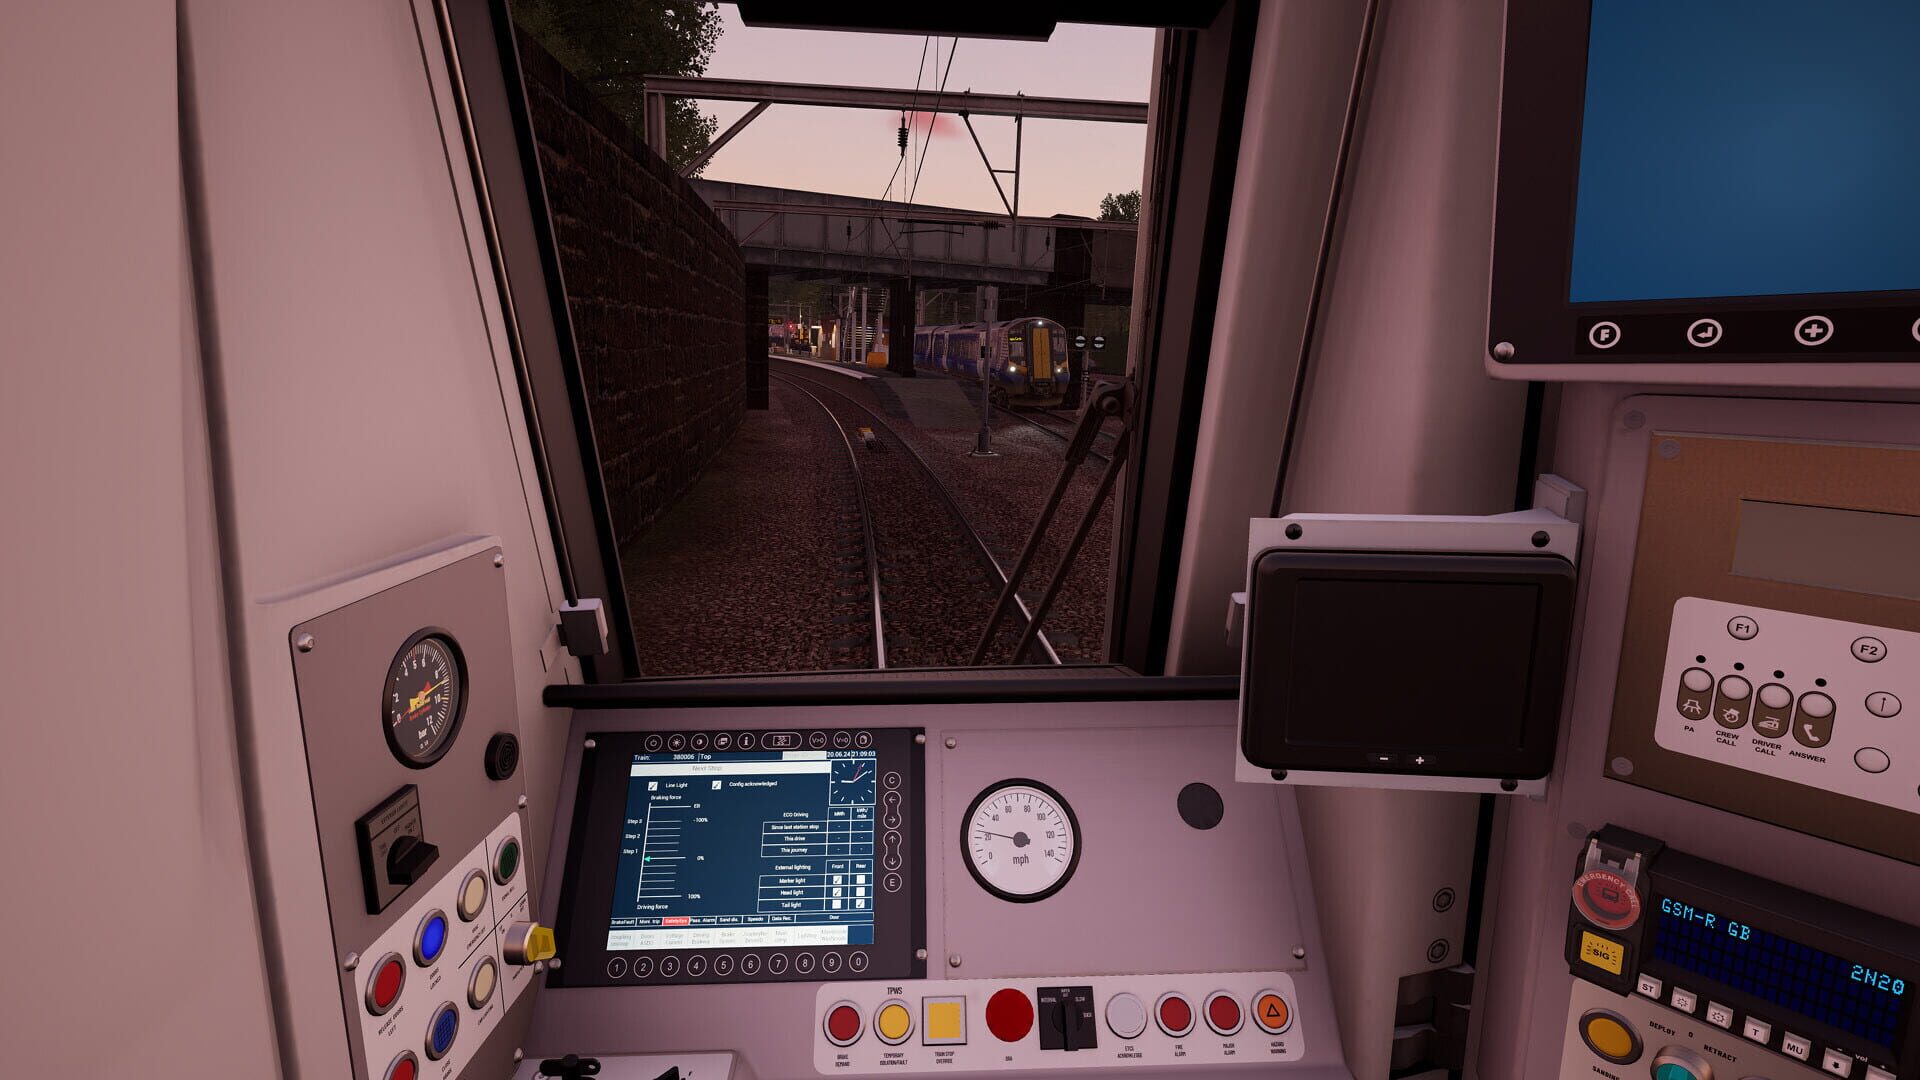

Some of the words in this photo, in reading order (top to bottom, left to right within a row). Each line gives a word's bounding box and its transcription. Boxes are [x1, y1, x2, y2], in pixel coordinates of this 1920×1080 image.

[1600, 329, 1610, 342] F
[1735, 623, 1750, 634] F1
[1860, 644, 1878, 656] F2
[412, 660, 417, 669] 5
[434, 694, 441, 704] 10
[426, 715, 434, 726] 12
[418, 728, 428, 739] bar
[1716, 730, 1739, 740] CREW
[1716, 737, 1737, 746] CALL
[1752, 738, 1782, 751] DRIVER
[1754, 746, 1776, 757] CALL
[1789, 750, 1826, 764] ANSWER
[1044, 850, 1054, 858] 140
[1013, 854, 1029, 866] mph
[1577, 872, 1626, 887] EMERGENCY
[1662, 899, 1716, 929] GSM-R
[1728, 922, 1750, 941] GB
[1593, 948, 1610, 960] SIG
[615, 964, 619, 972] 1
[748, 960, 753, 968] 6
[776, 960, 781, 968] 7
[803, 959, 808, 967] 8
[1851, 964, 1904, 995] 2N20
[887, 987, 903, 995] TPWS
[1642, 983, 1653, 993] ST
[1650, 1021, 1676, 1036] DEPLOY
[1752, 1028, 1759, 1037] T
[1704, 1044, 1737, 1063] RETRACT
[1787, 1043, 1803, 1055] MU
